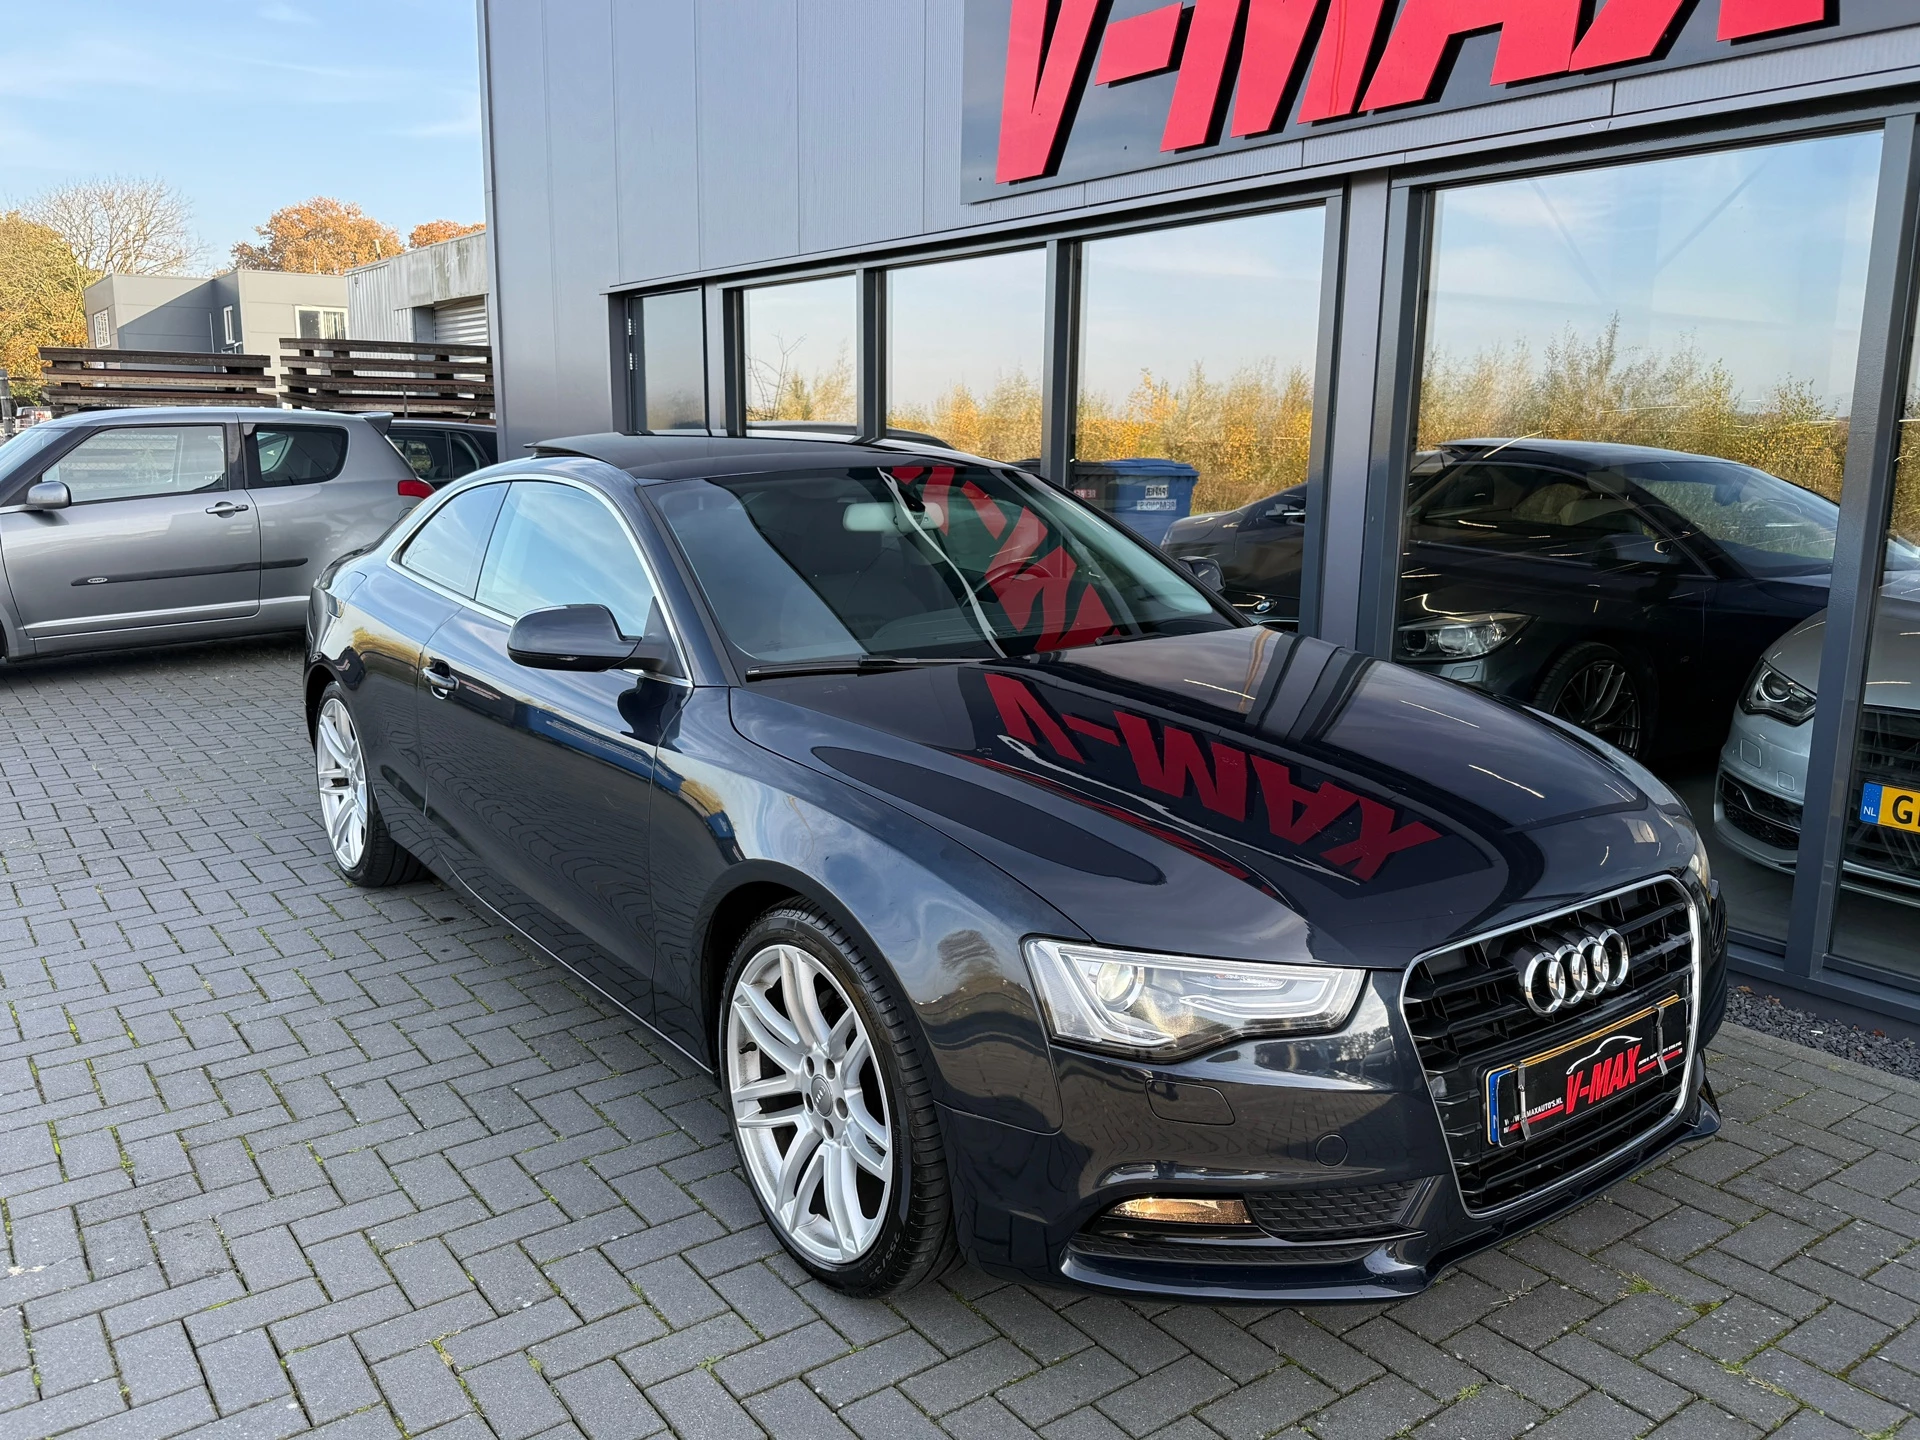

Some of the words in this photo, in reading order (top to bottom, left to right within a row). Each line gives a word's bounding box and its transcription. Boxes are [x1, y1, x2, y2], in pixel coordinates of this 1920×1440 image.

[996, 0, 1826, 186] V-M
[1863, 805, 1877, 817] NL
[1892, 795, 1920, 827] G
[1565, 1044, 1641, 1115] V-MAX
